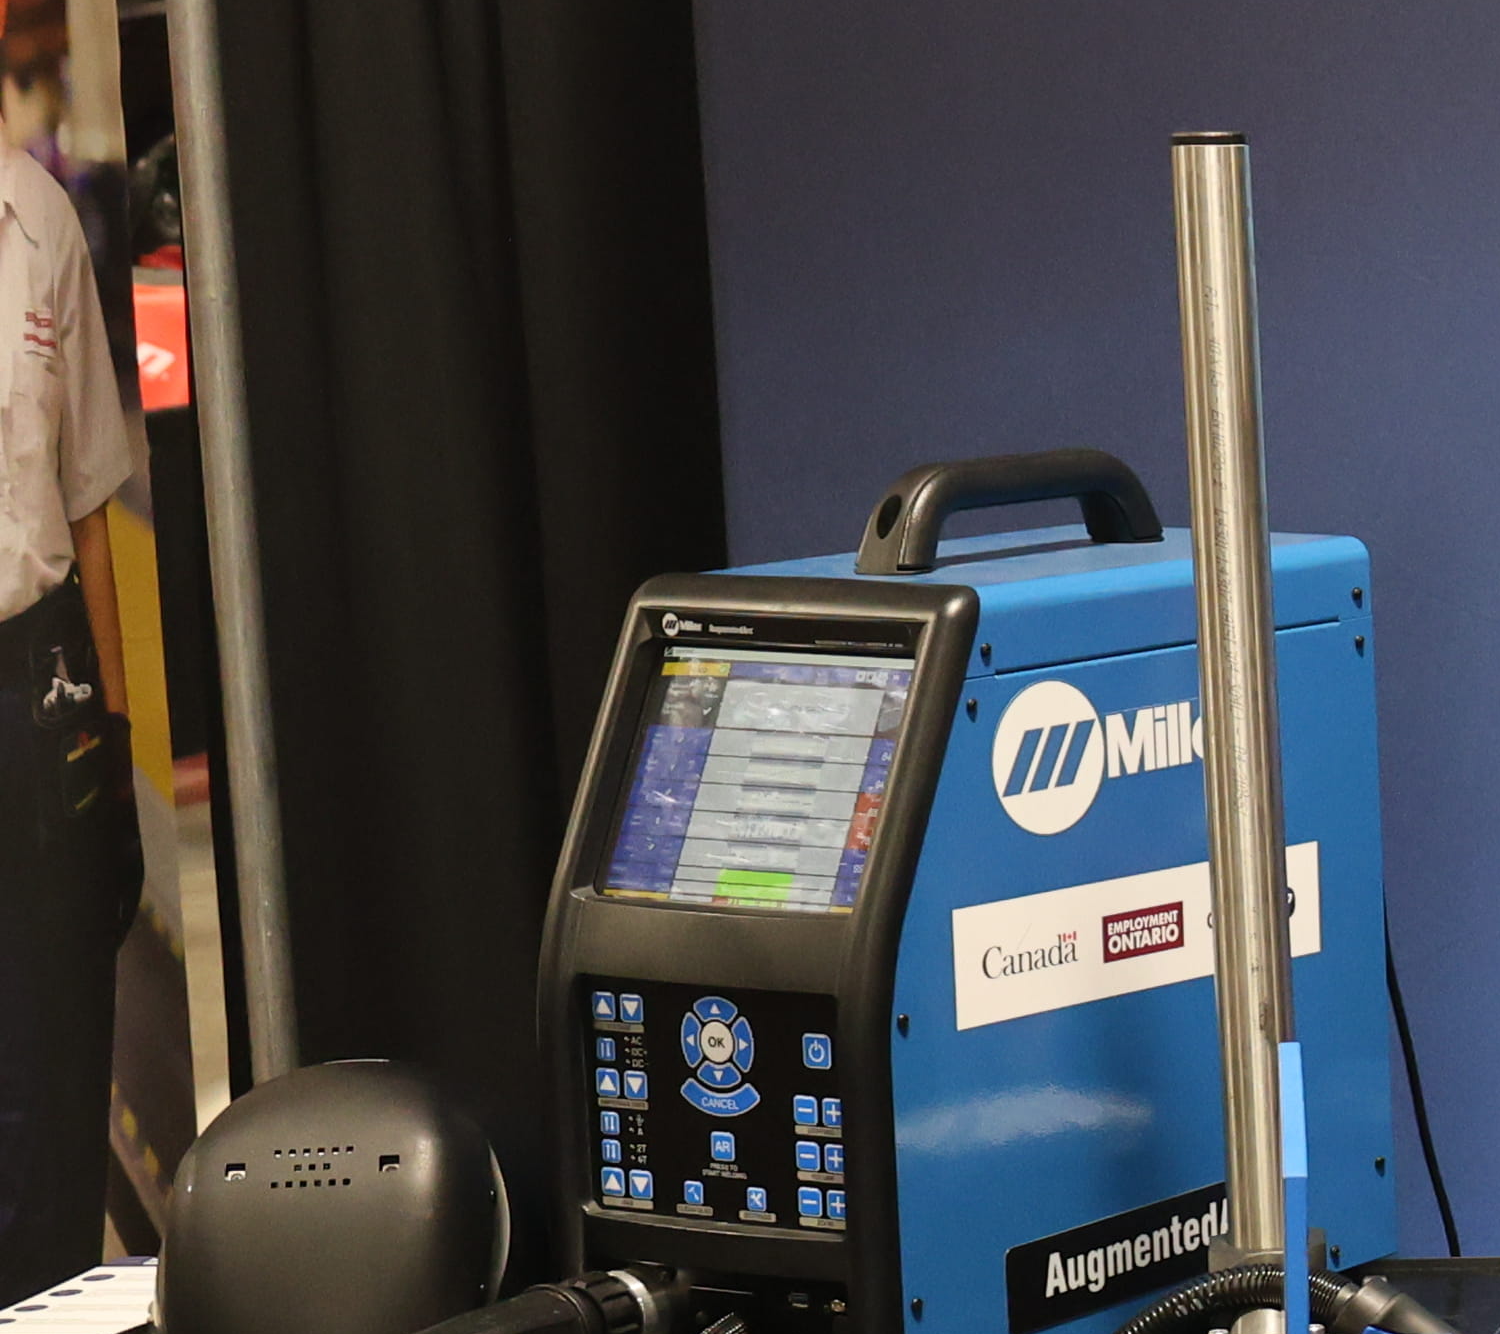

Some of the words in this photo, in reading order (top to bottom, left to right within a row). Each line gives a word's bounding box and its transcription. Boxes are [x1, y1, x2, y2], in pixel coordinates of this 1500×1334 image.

[1105, 701, 1205, 779] Mill
[1107, 909, 1179, 936] EMPLOYMENT
[1108, 924, 1180, 955] ONTARIO
[982, 932, 1079, 980] Canada
[708, 1036, 726, 1049] OK
[701, 1097, 740, 1110] CANCEL
[714, 1141, 731, 1153] AR
